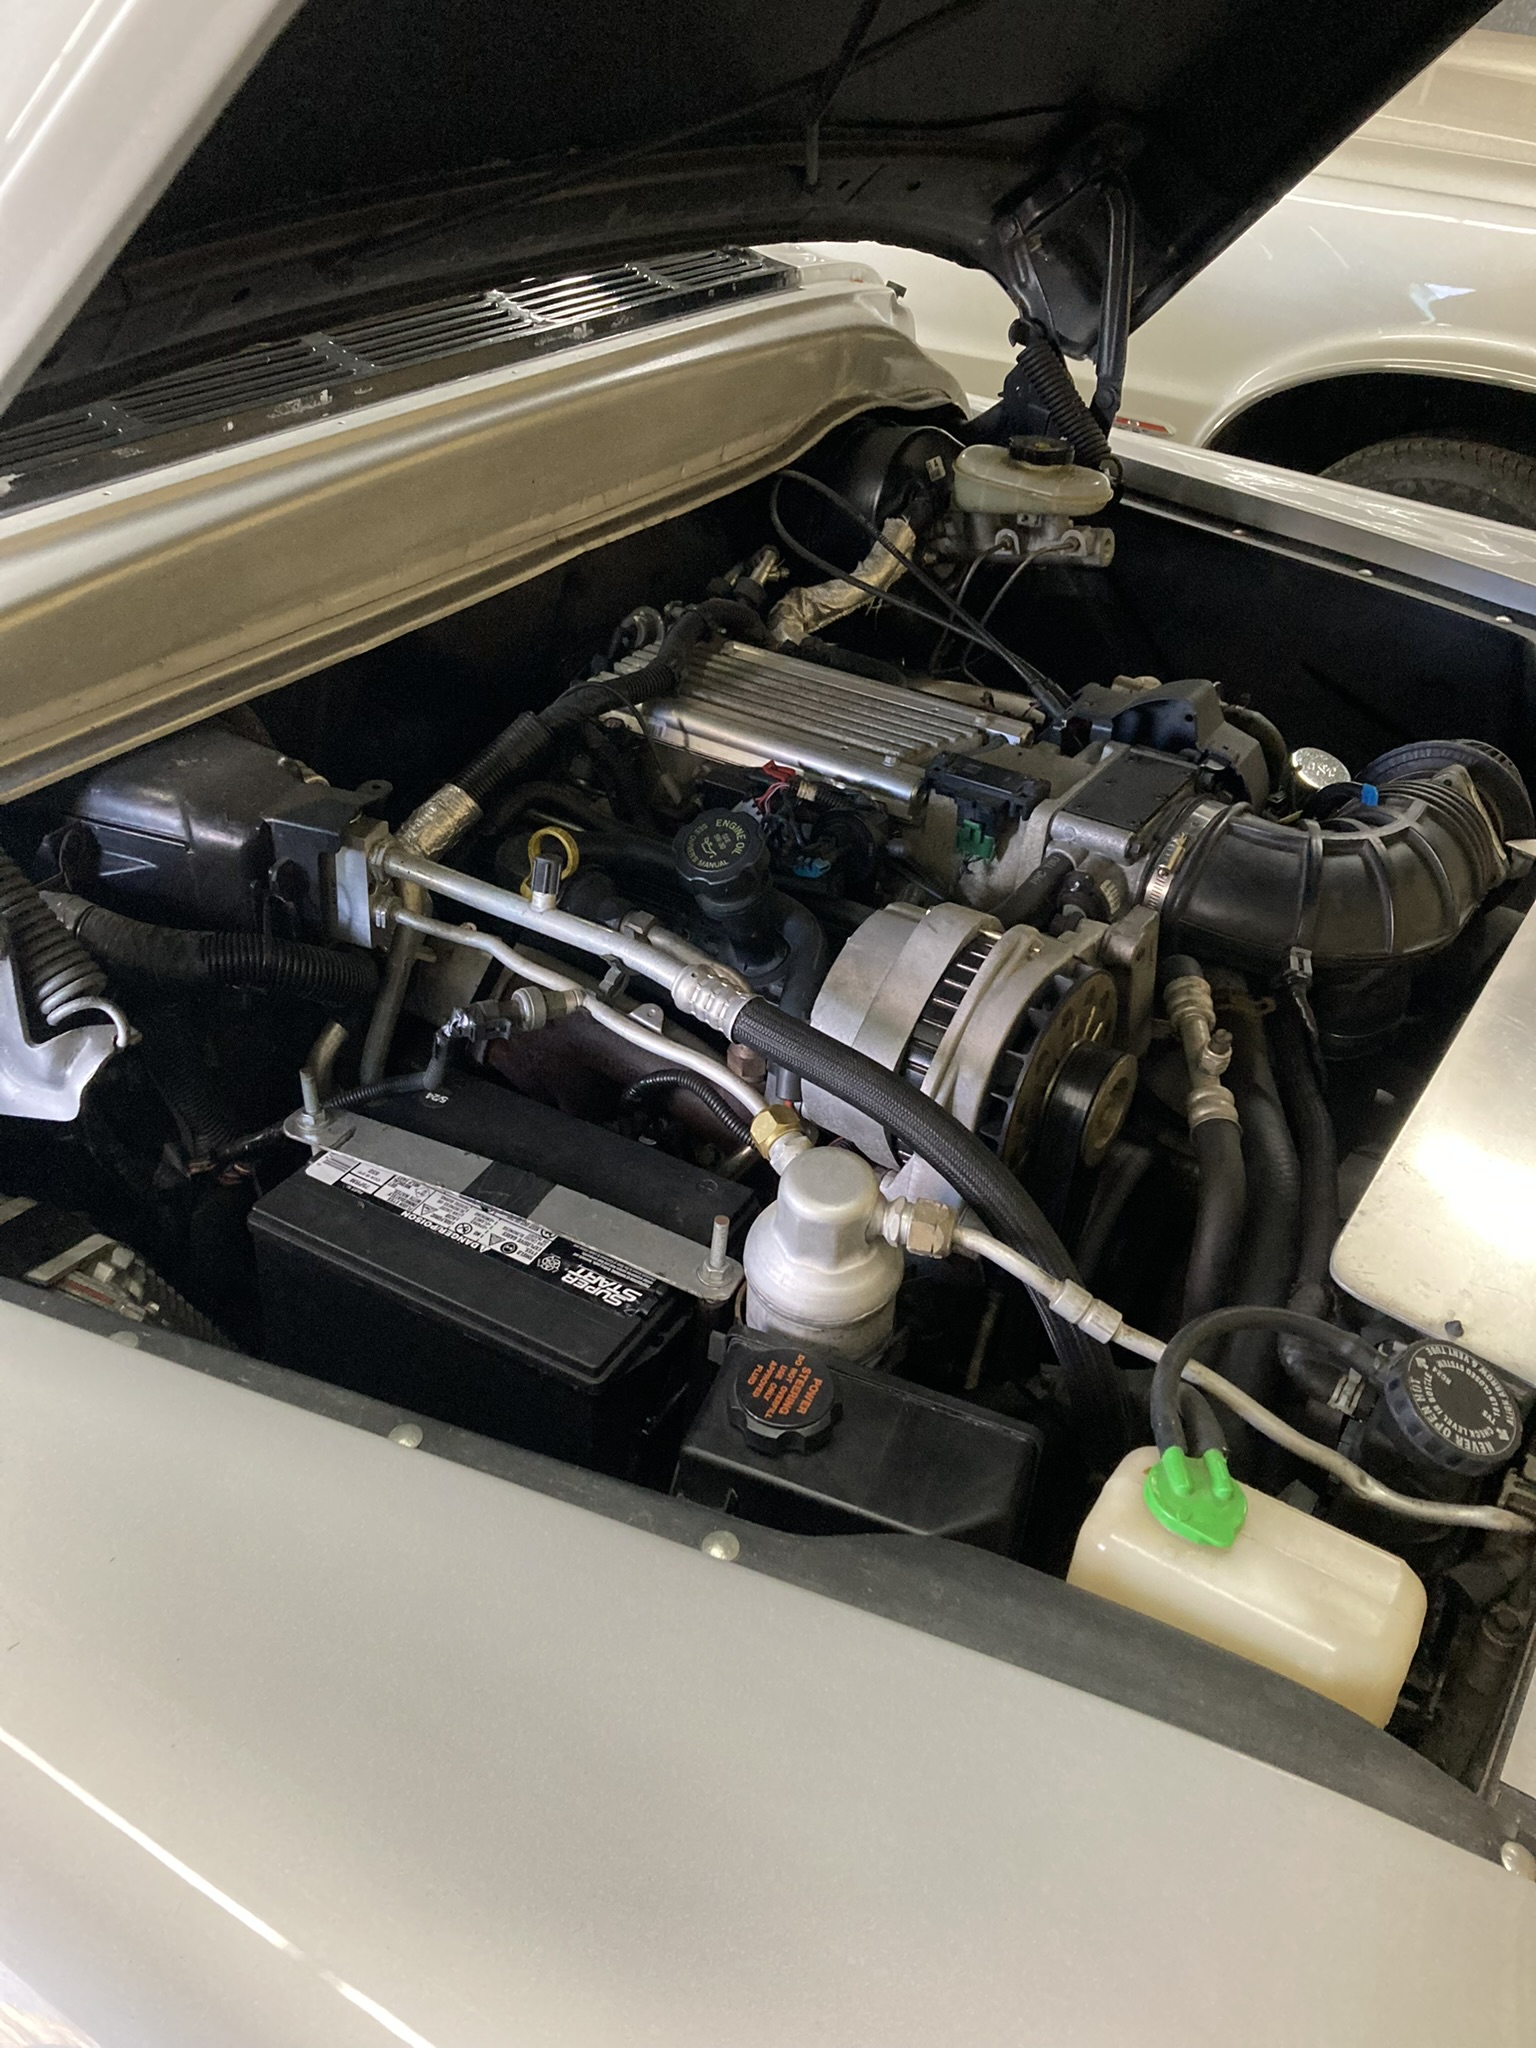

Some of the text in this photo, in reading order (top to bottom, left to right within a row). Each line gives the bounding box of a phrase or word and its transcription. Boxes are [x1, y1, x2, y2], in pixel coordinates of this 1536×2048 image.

[715, 819, 746, 855] ENGINE OIL
[697, 860, 729, 868] MANUAL
[400, 1210, 480, 1249] DANGER/POISON
[561, 1273, 622, 1307] SUPER
[567, 1267, 643, 1302] START
[794, 1353, 806, 1367] DO
[1436, 1359, 1465, 1372] SYSTEM
[1448, 1347, 1470, 1364] VENT
[747, 1363, 764, 1385] FLUID
[786, 1367, 798, 1384] NOT
[1466, 1368, 1492, 1395] CLOSED
[1478, 1367, 1509, 1400] ARROW
[778, 1366, 812, 1415] STEERING
[796, 1377, 823, 1415] POWER
[1408, 1376, 1495, 1453] NEVER OPEN HOT
[1443, 1414, 1468, 1436] LEVEL
[1468, 1426, 1494, 1438] CHECK
